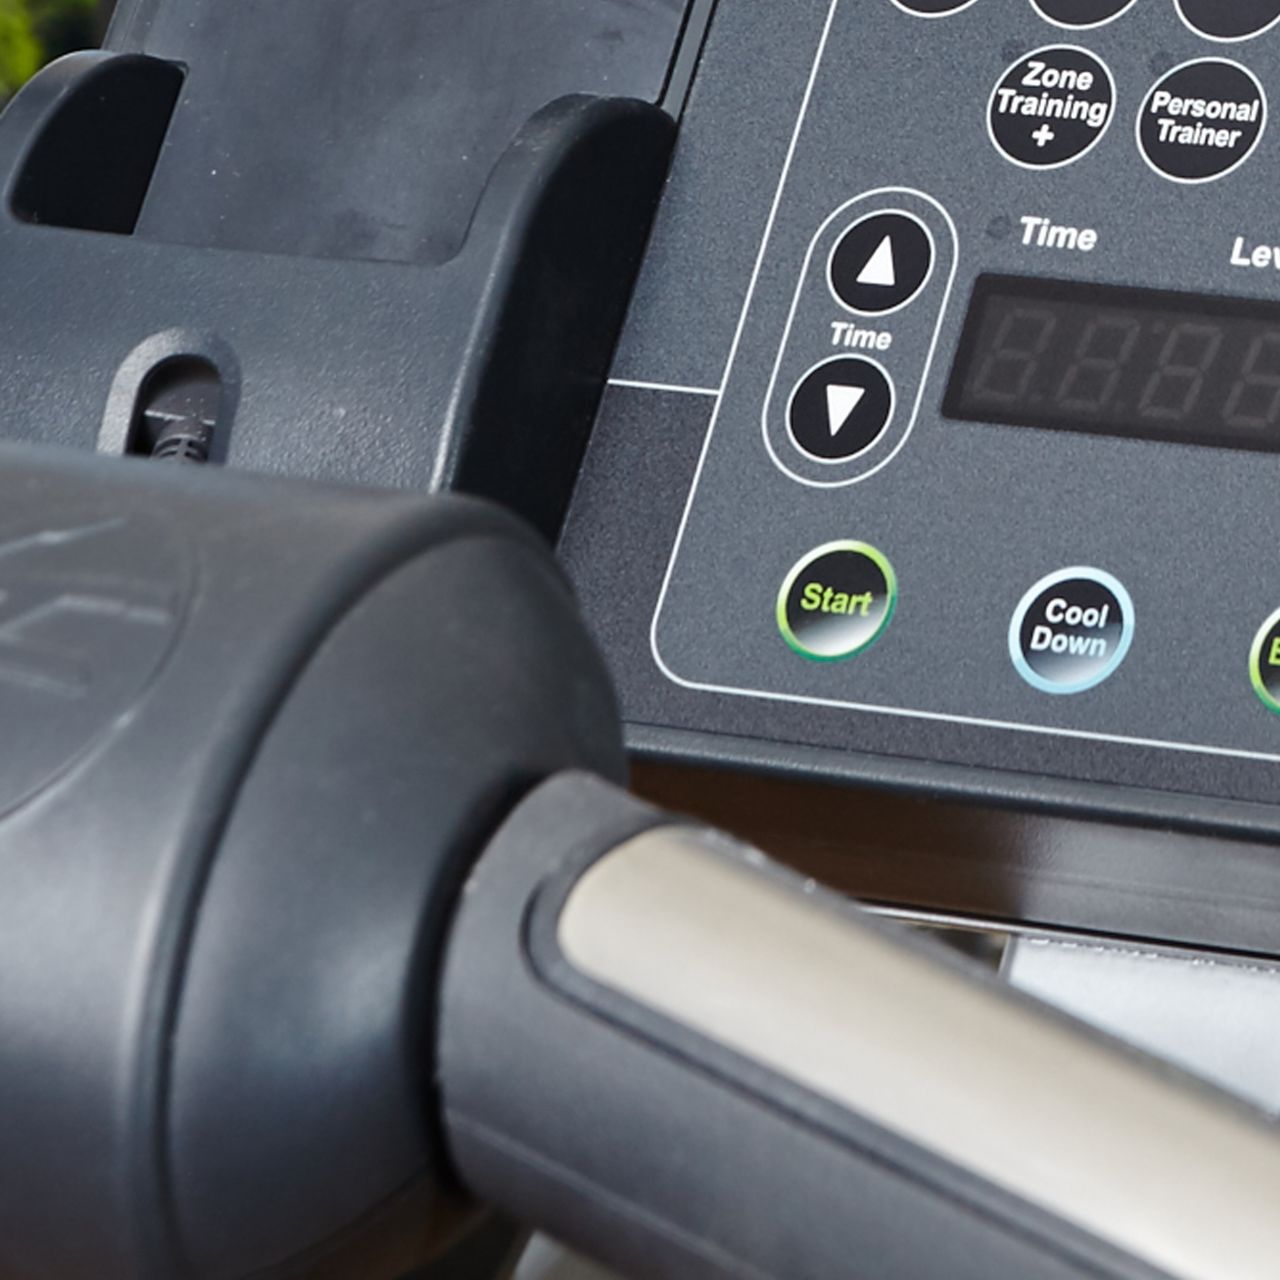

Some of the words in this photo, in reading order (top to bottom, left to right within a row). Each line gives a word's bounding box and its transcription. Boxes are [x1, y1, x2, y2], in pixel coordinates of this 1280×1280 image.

[1021, 62, 1094, 92] Zone
[996, 89, 1108, 128] Training
[1150, 91, 1259, 123] Personal
[1157, 119, 1242, 150] Trainer
[1019, 217, 1098, 252] Time
[830, 322, 893, 351] Time
[799, 583, 873, 618] Start
[1044, 597, 1110, 629] Cool
[1030, 626, 1107, 657] Down
